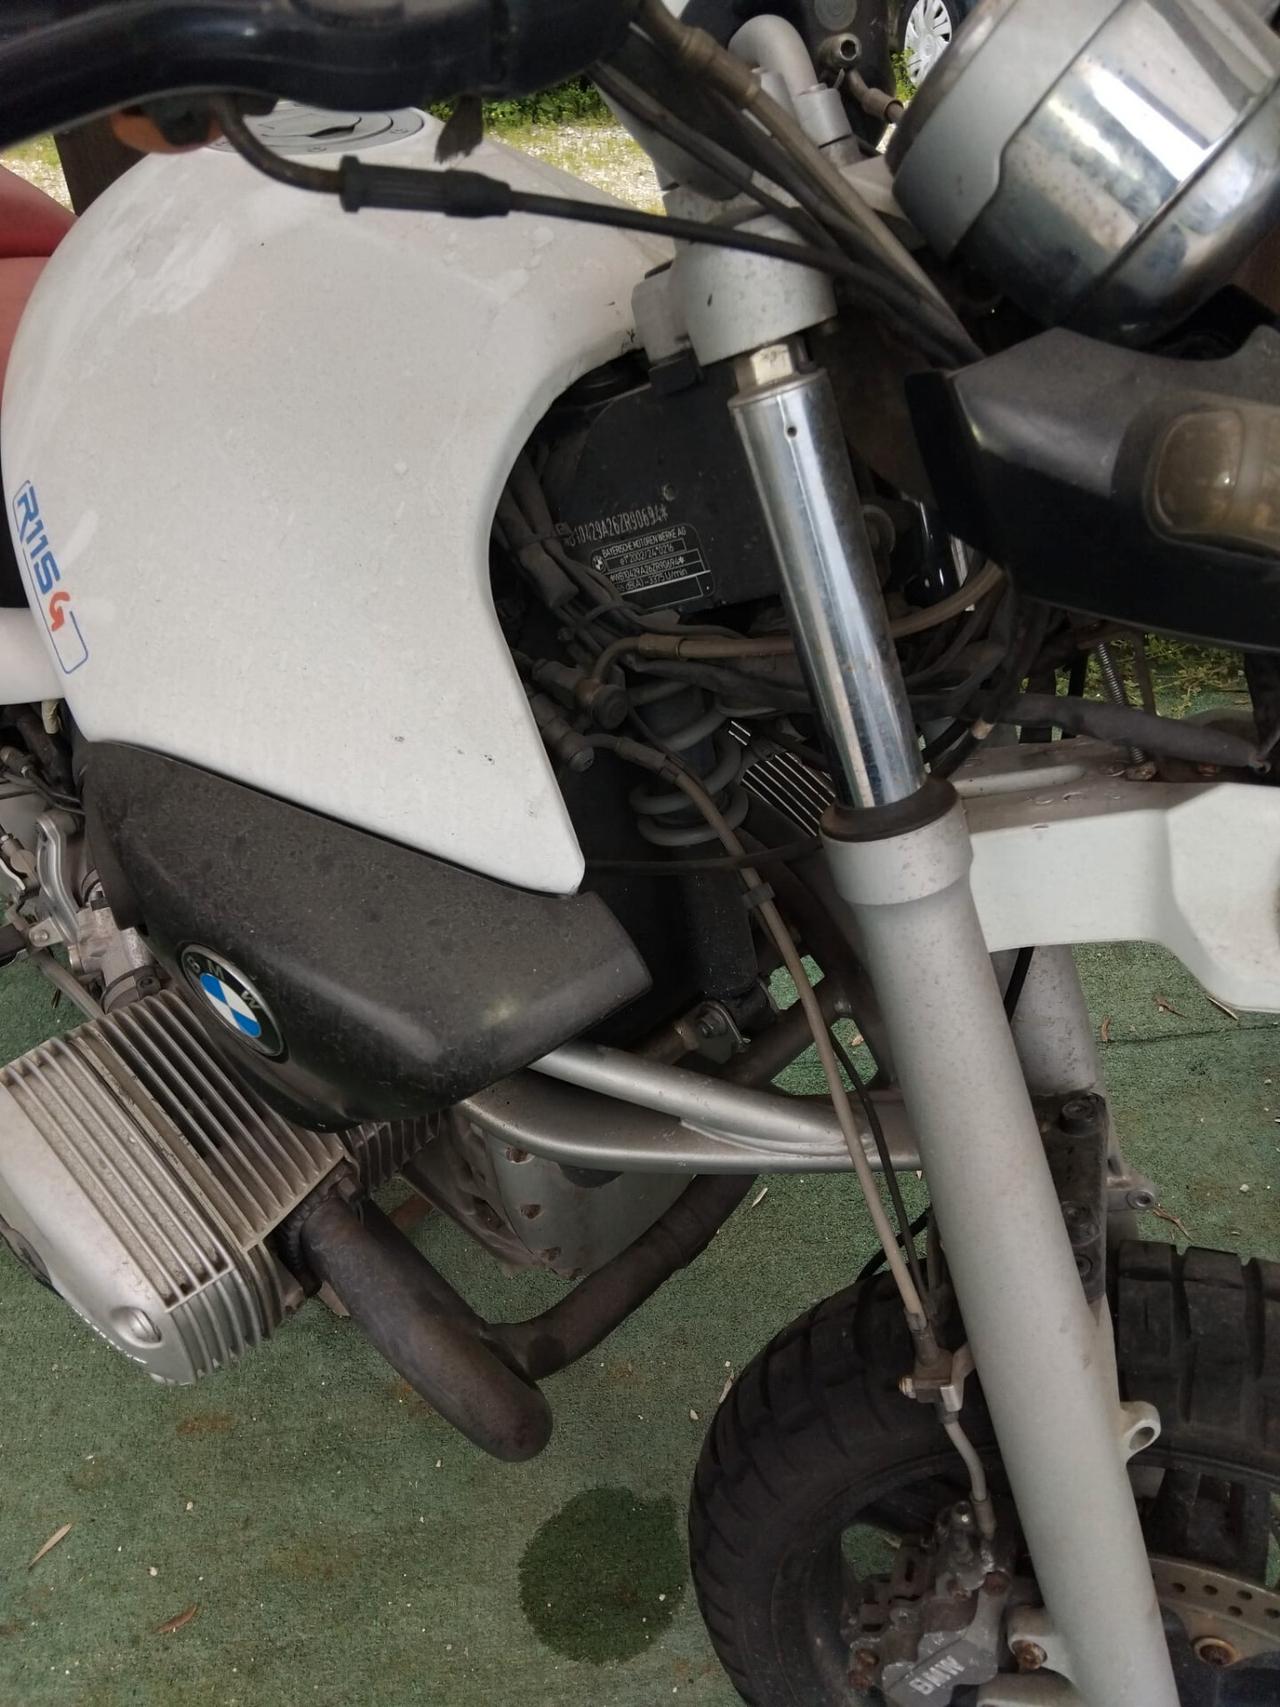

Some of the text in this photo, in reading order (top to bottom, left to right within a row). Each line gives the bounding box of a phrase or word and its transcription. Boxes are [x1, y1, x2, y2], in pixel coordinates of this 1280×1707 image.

[678, 526, 687, 537] AG
[186, 955, 261, 1010] BMW
[909, 1655, 965, 1695] BMW
